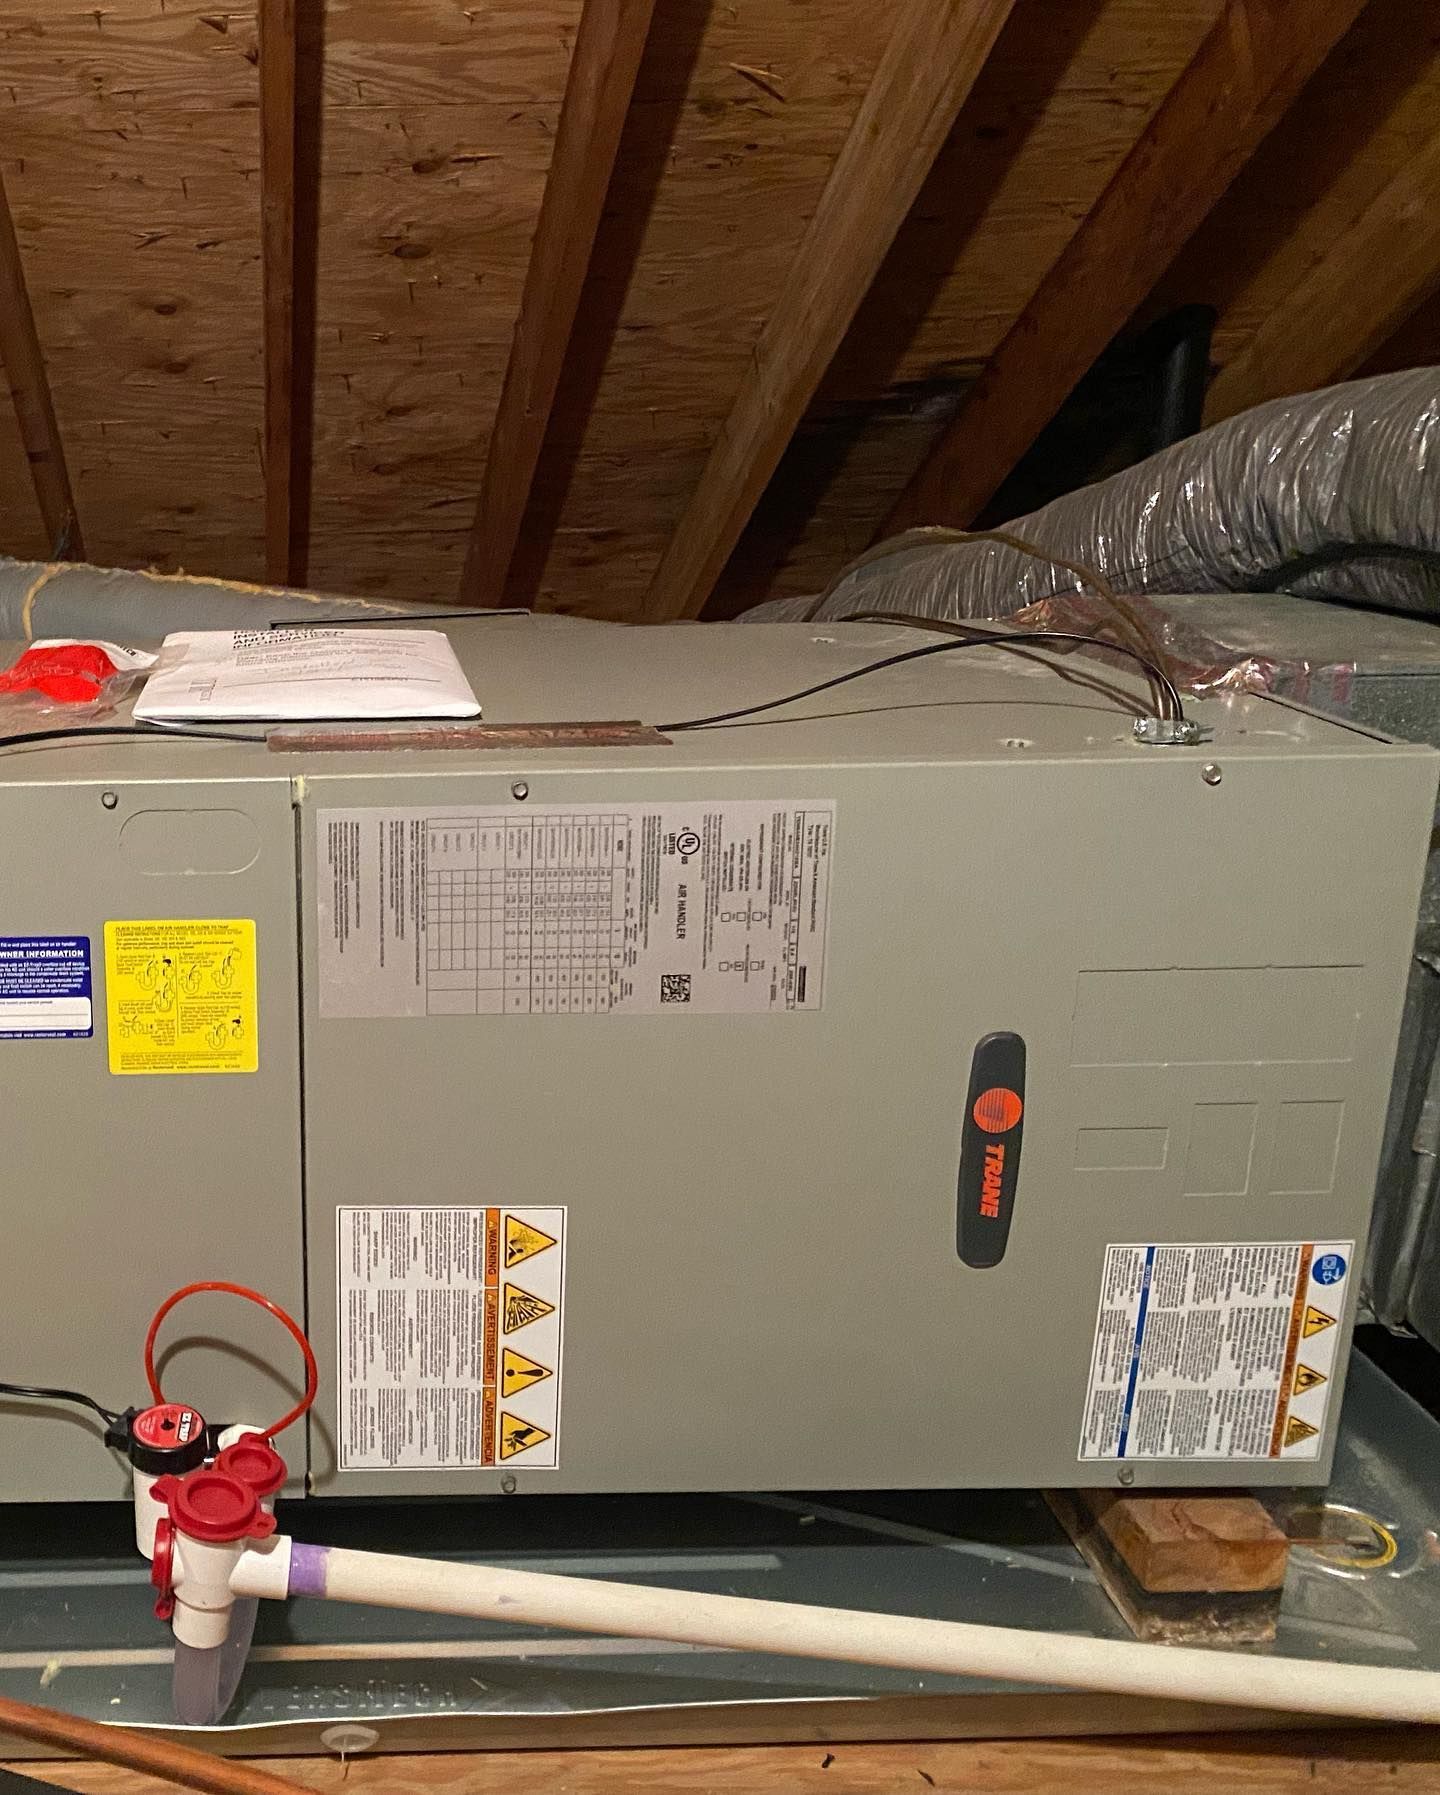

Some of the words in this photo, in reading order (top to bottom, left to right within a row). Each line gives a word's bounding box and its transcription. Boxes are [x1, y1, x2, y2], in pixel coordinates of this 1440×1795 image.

[681, 837, 694, 848] UL
[677, 883, 687, 898] AIR
[676, 900, 686, 939] HANDLER
[26, 950, 84, 958] INFORMATION
[979, 1144, 1005, 1218] TRANE
[487, 1229, 497, 1275] WARNING
[1142, 1264, 1152, 1288] NOTICE
[485, 1303, 496, 1380] AVERTISSEMENT
[483, 1399, 493, 1463] ADVERTENCIA
